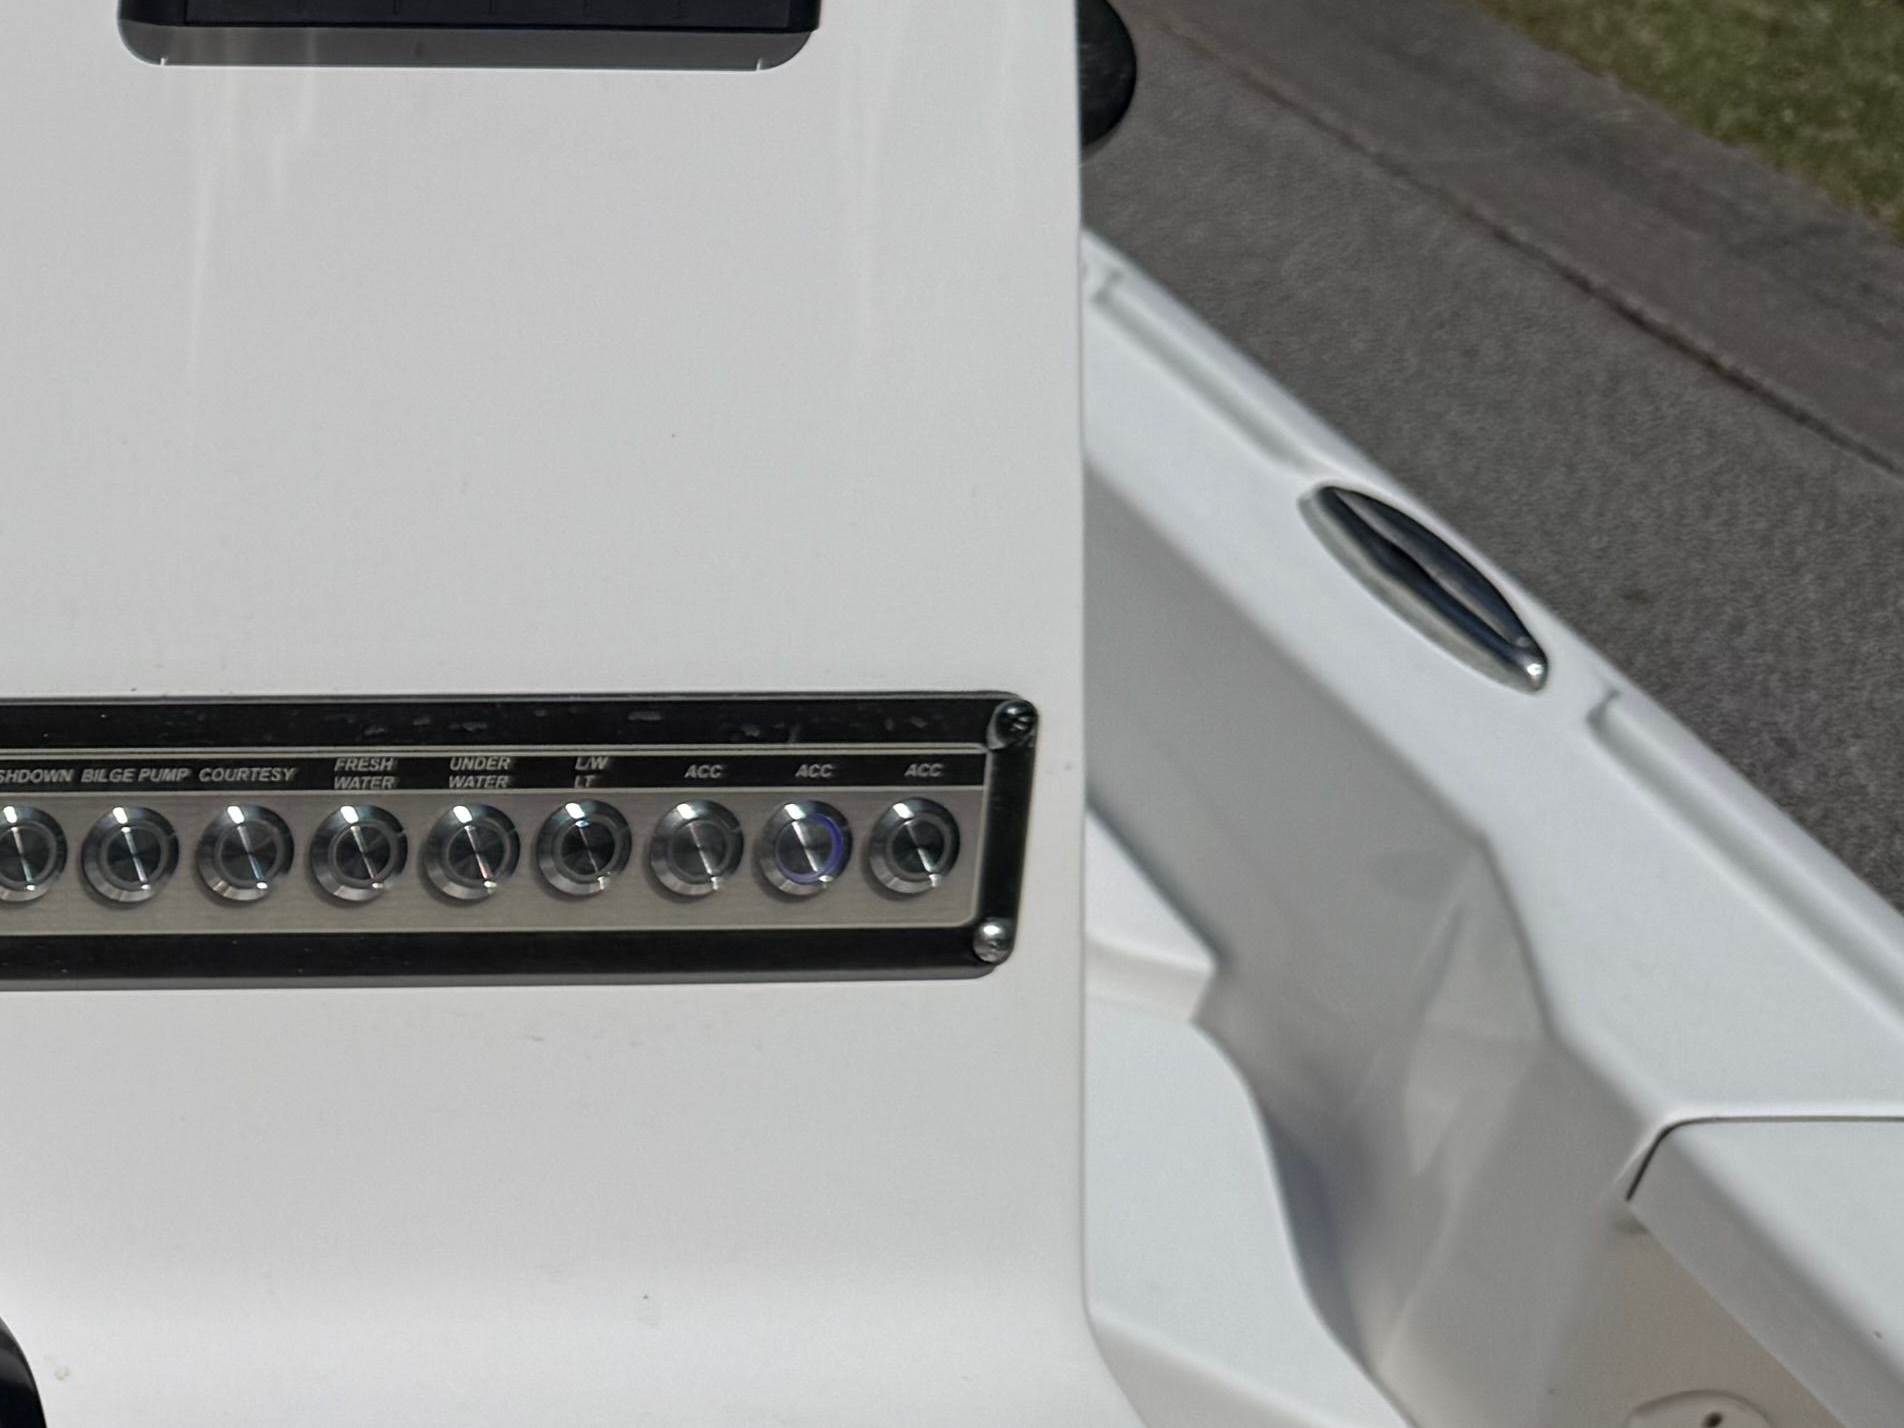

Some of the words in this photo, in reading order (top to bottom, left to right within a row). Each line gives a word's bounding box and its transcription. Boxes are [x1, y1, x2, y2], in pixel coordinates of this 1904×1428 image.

[334, 756, 393, 772] FRESH
[449, 755, 511, 771] UNDER
[795, 763, 833, 779] ACC
[904, 762, 942, 778] ACC
[80, 767, 136, 783] BILGE
[139, 767, 191, 783] PUMP
[198, 766, 297, 783] COURTESY
[684, 764, 723, 779] ACC
[333, 775, 394, 790] WATER
[448, 775, 509, 790] WATER
[574, 775, 595, 790] LT
